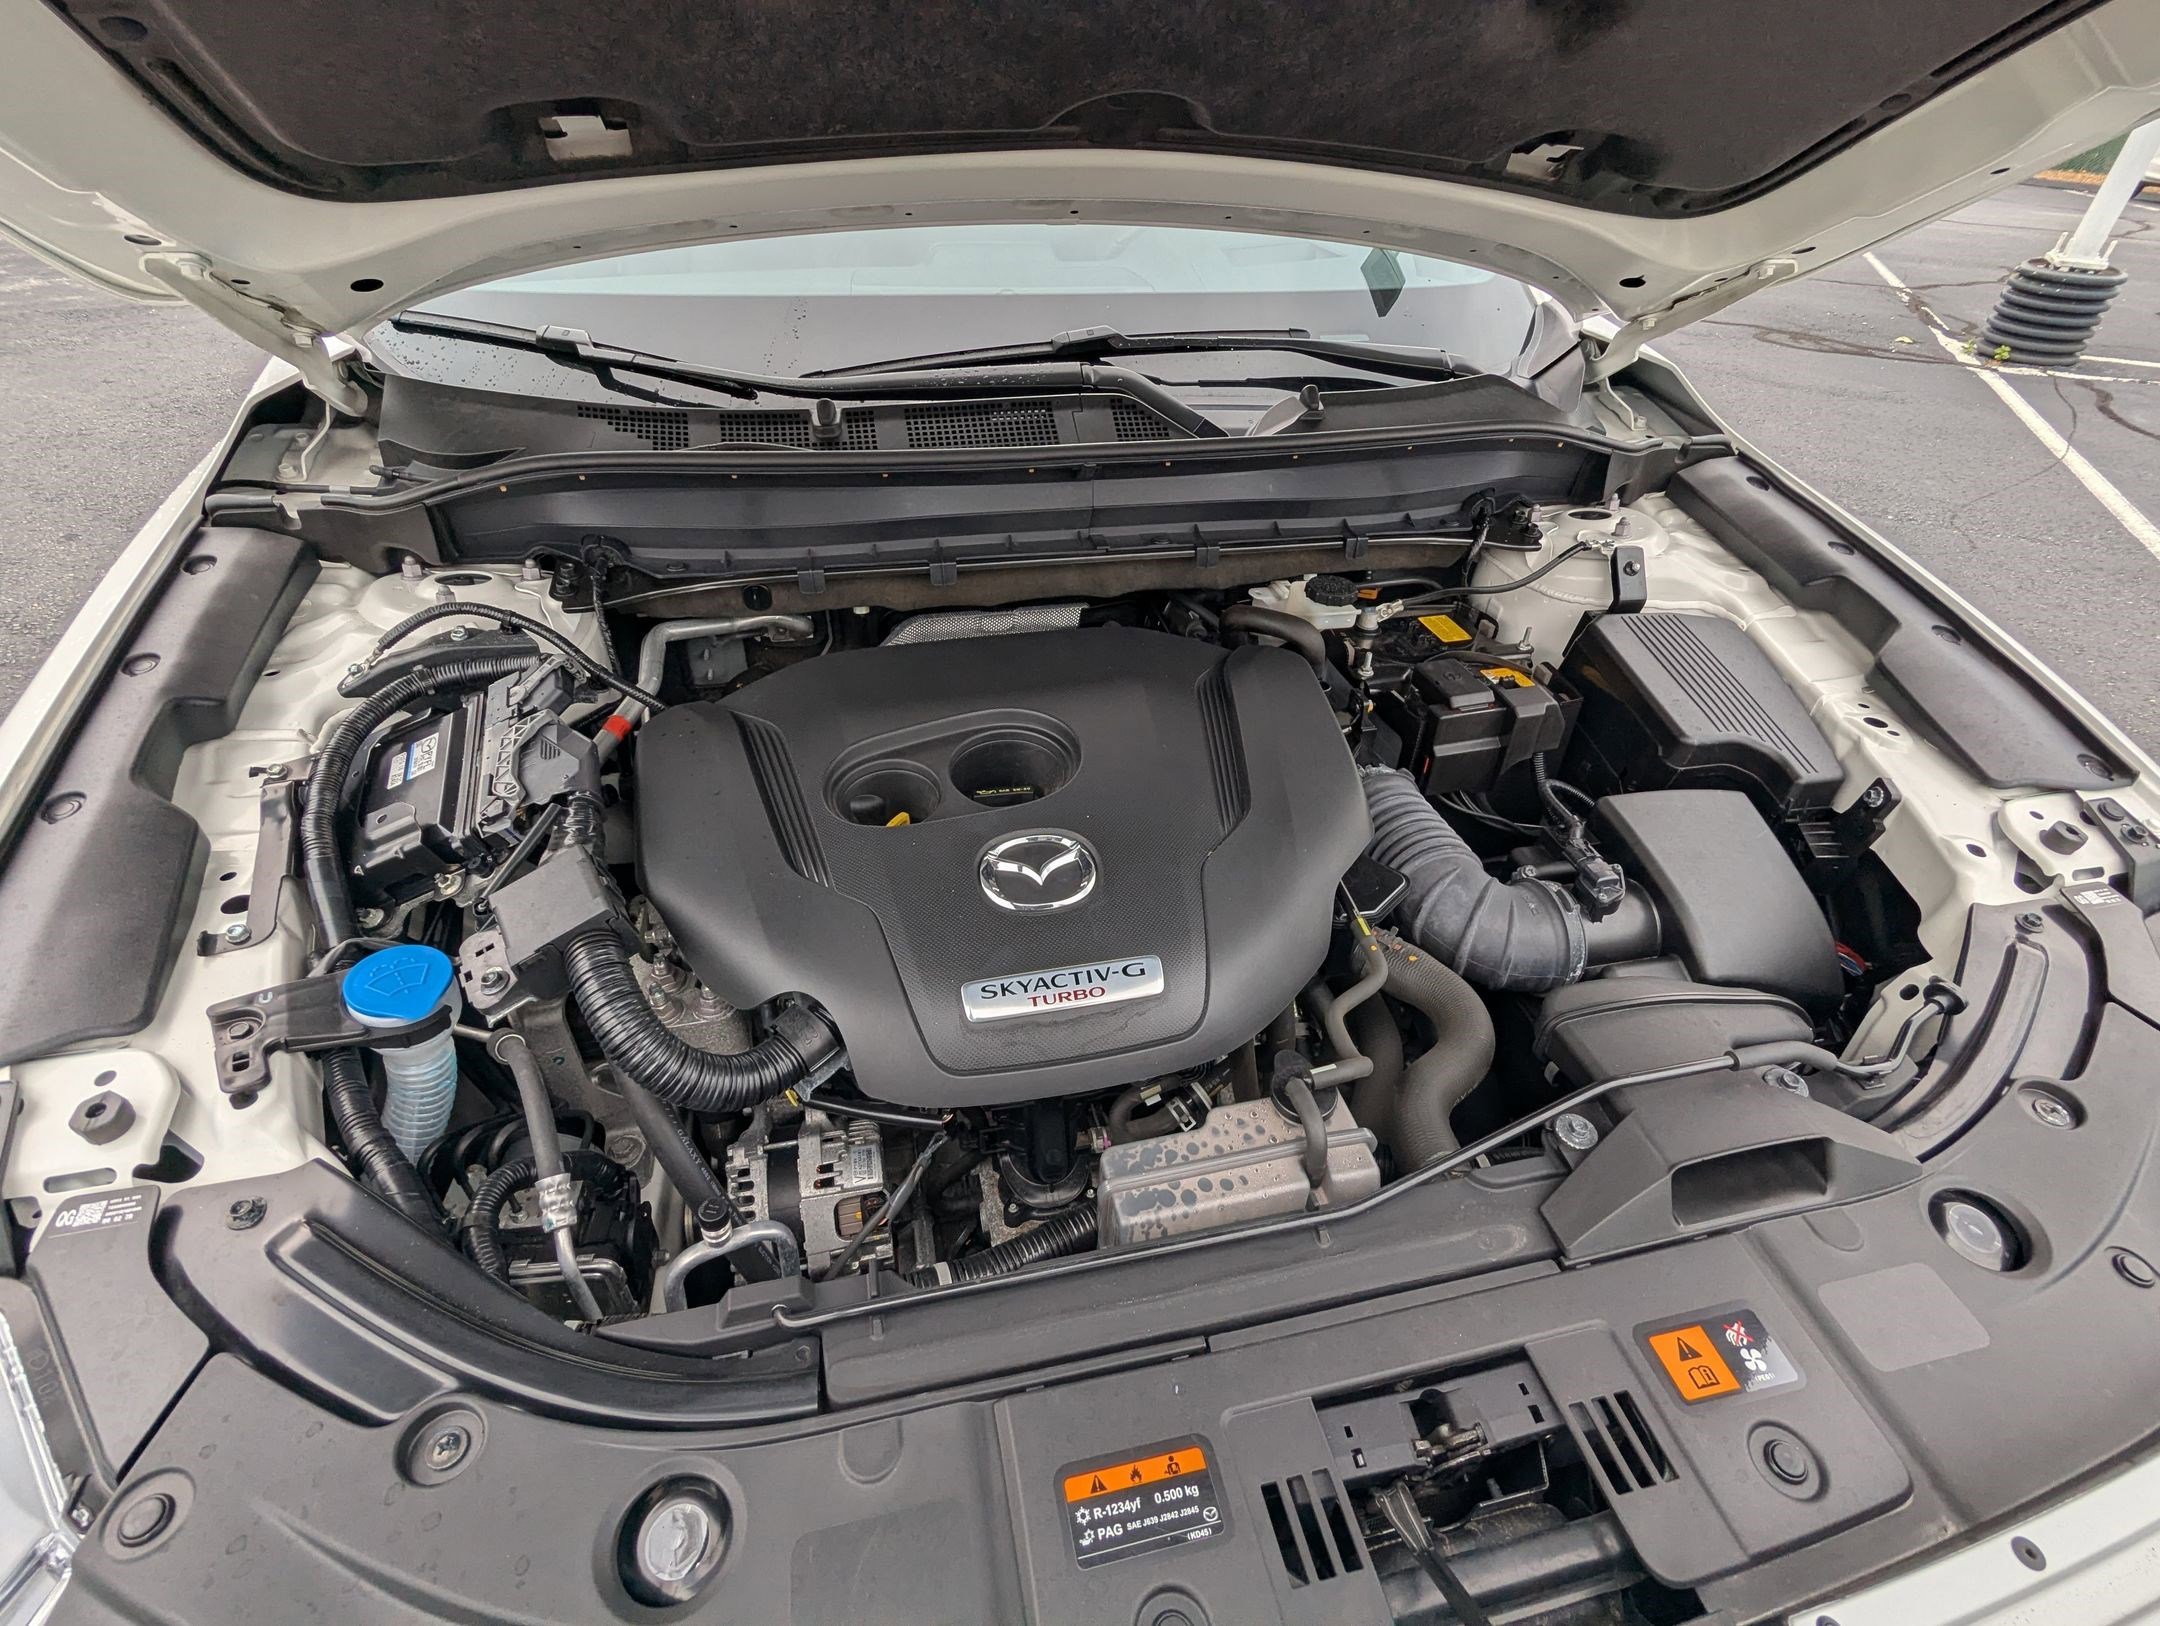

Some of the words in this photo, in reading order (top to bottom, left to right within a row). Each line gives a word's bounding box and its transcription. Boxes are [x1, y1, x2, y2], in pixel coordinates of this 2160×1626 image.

[980, 962, 1146, 1000] SKYACTIV-G
[1027, 986, 1106, 1007] TURBO
[1093, 1496, 1142, 1520] R-1234yf
[1154, 1487, 1183, 1504] 0.500
[1184, 1484, 1200, 1498] kg
[1097, 1523, 1123, 1541] PAG
[1126, 1520, 1142, 1531] SAE
[1159, 1510, 1180, 1523] J2842
[1179, 1505, 1200, 1518] J2845
[1187, 1527, 1212, 1541] (KD45)
